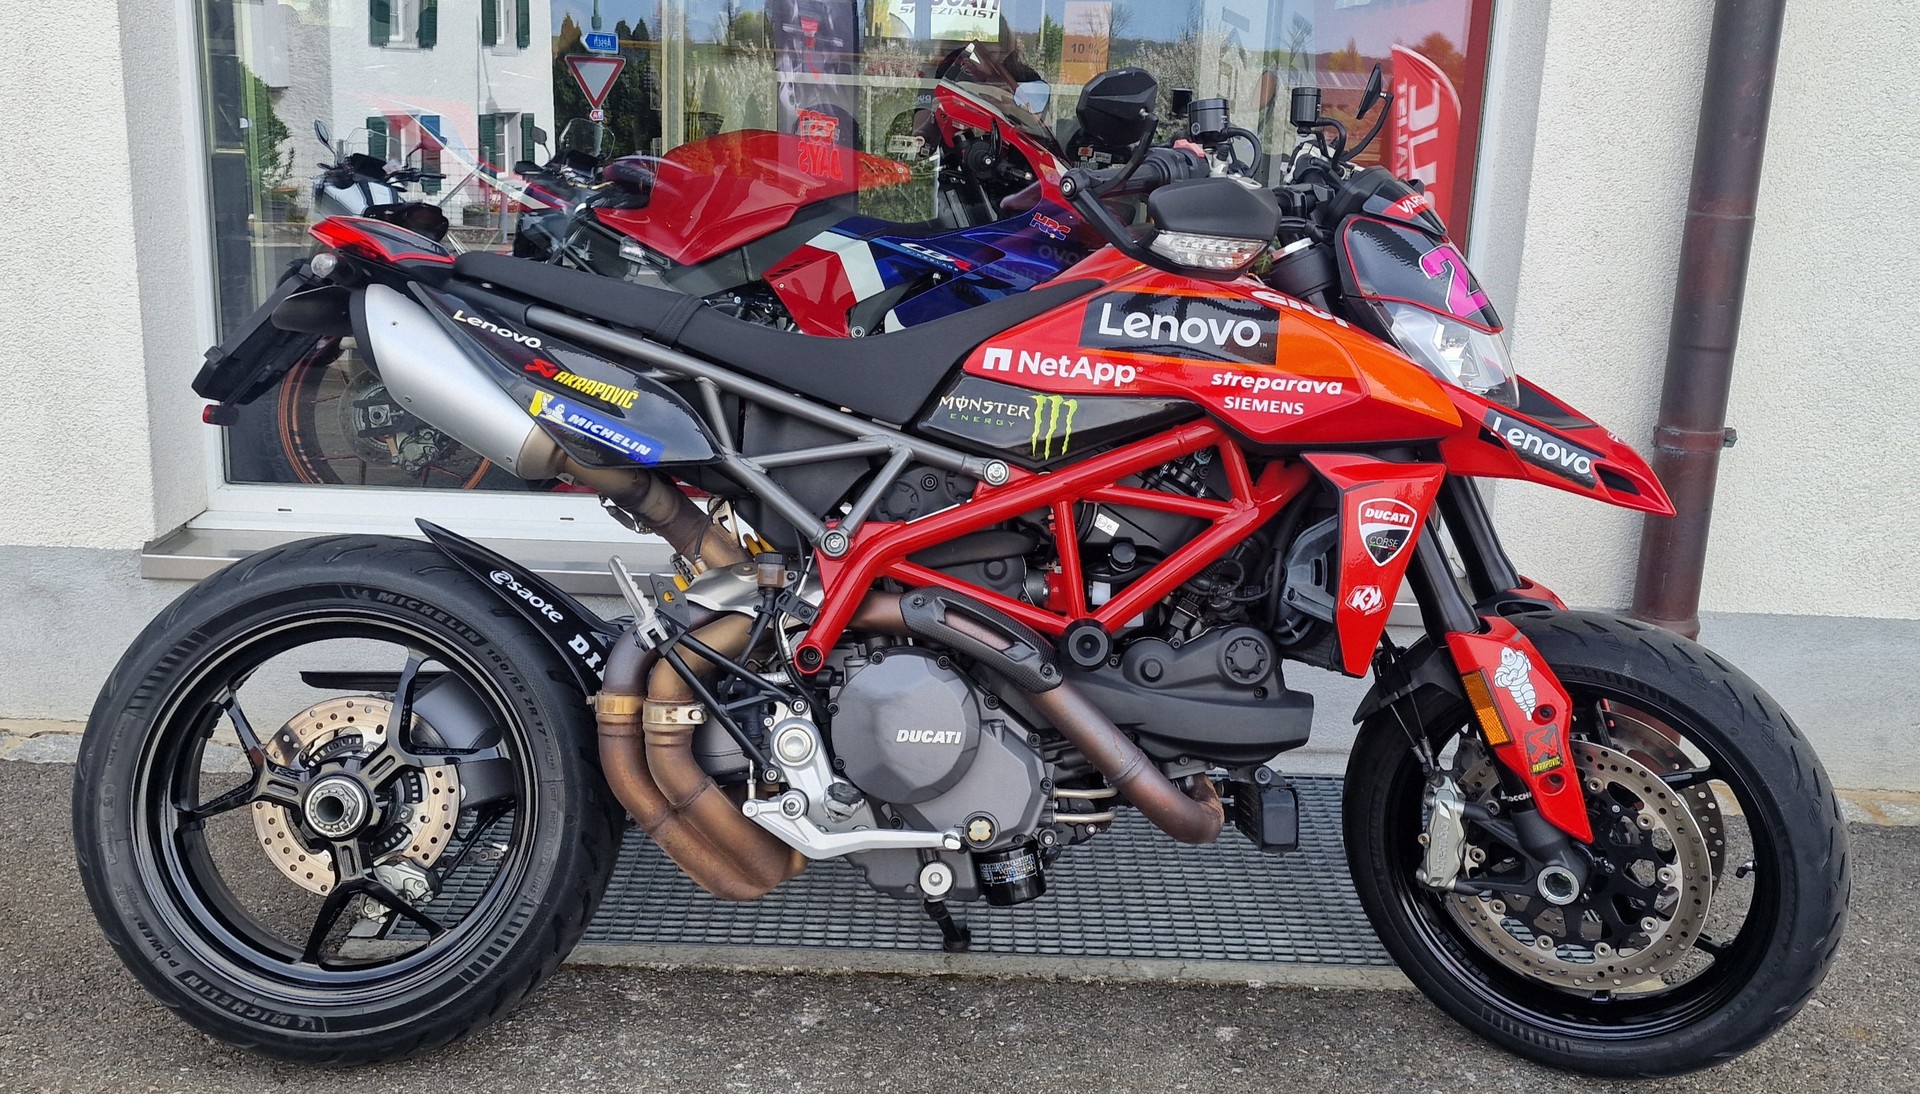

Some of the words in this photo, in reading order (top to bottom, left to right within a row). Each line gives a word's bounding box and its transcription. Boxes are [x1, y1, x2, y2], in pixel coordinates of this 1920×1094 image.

[1071, 43, 1085, 54] 10
[1030, 212, 1071, 241] HRC
[453, 309, 542, 350] Lenovo
[1098, 302, 1261, 348] Lenovo
[1017, 350, 1137, 387] NetApp
[1210, 371, 1343, 395] streparava
[939, 395, 1031, 420] MONSTER
[950, 412, 1015, 427] ENERGY
[1223, 396, 1304, 415] SIEMENS
[567, 414, 652, 456] MICHELIN
[1490, 416, 1591, 475] Lenovo
[1364, 507, 1410, 524] DUCATI
[1369, 535, 1399, 548] CORSE
[376, 591, 482, 643] MICHELIN
[486, 648, 526, 693] 180/55
[523, 697, 538, 717] ZR
[895, 729, 962, 744] DUCATI
[135, 920, 181, 969] POWER
[184, 976, 292, 1027] MICHELIN
